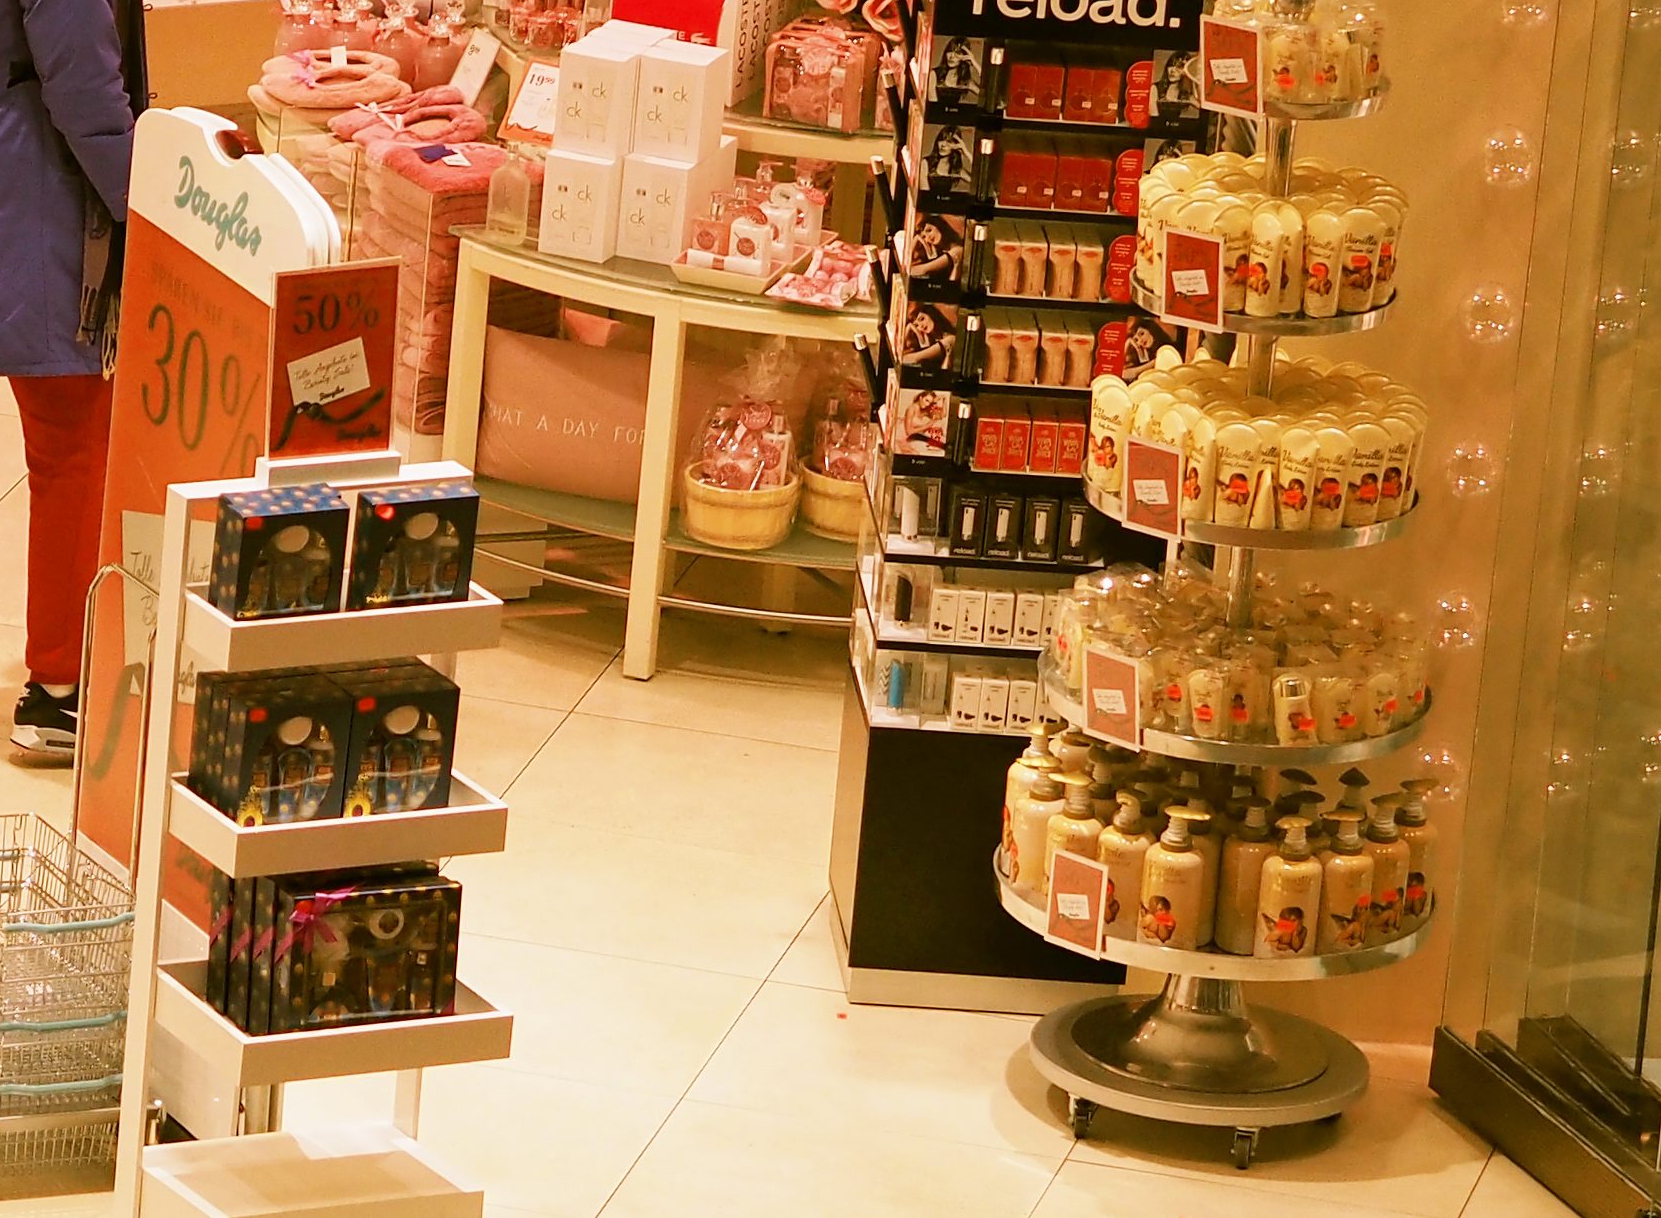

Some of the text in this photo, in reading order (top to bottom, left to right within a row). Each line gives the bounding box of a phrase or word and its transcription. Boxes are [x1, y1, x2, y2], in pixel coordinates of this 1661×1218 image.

[592, 82, 607, 98] ck
[673, 86, 688, 103] ck
[566, 101, 582, 118] ck
[647, 105, 663, 122] ck
[577, 185, 592, 202] ck
[656, 189, 672, 206] ck
[174, 155, 262, 257] Douglas
[552, 204, 567, 221] ck
[630, 208, 645, 225] ck
[292, 290, 381, 335] 50%
[536, 414, 549, 432] A
[562, 418, 599, 438] DAY
